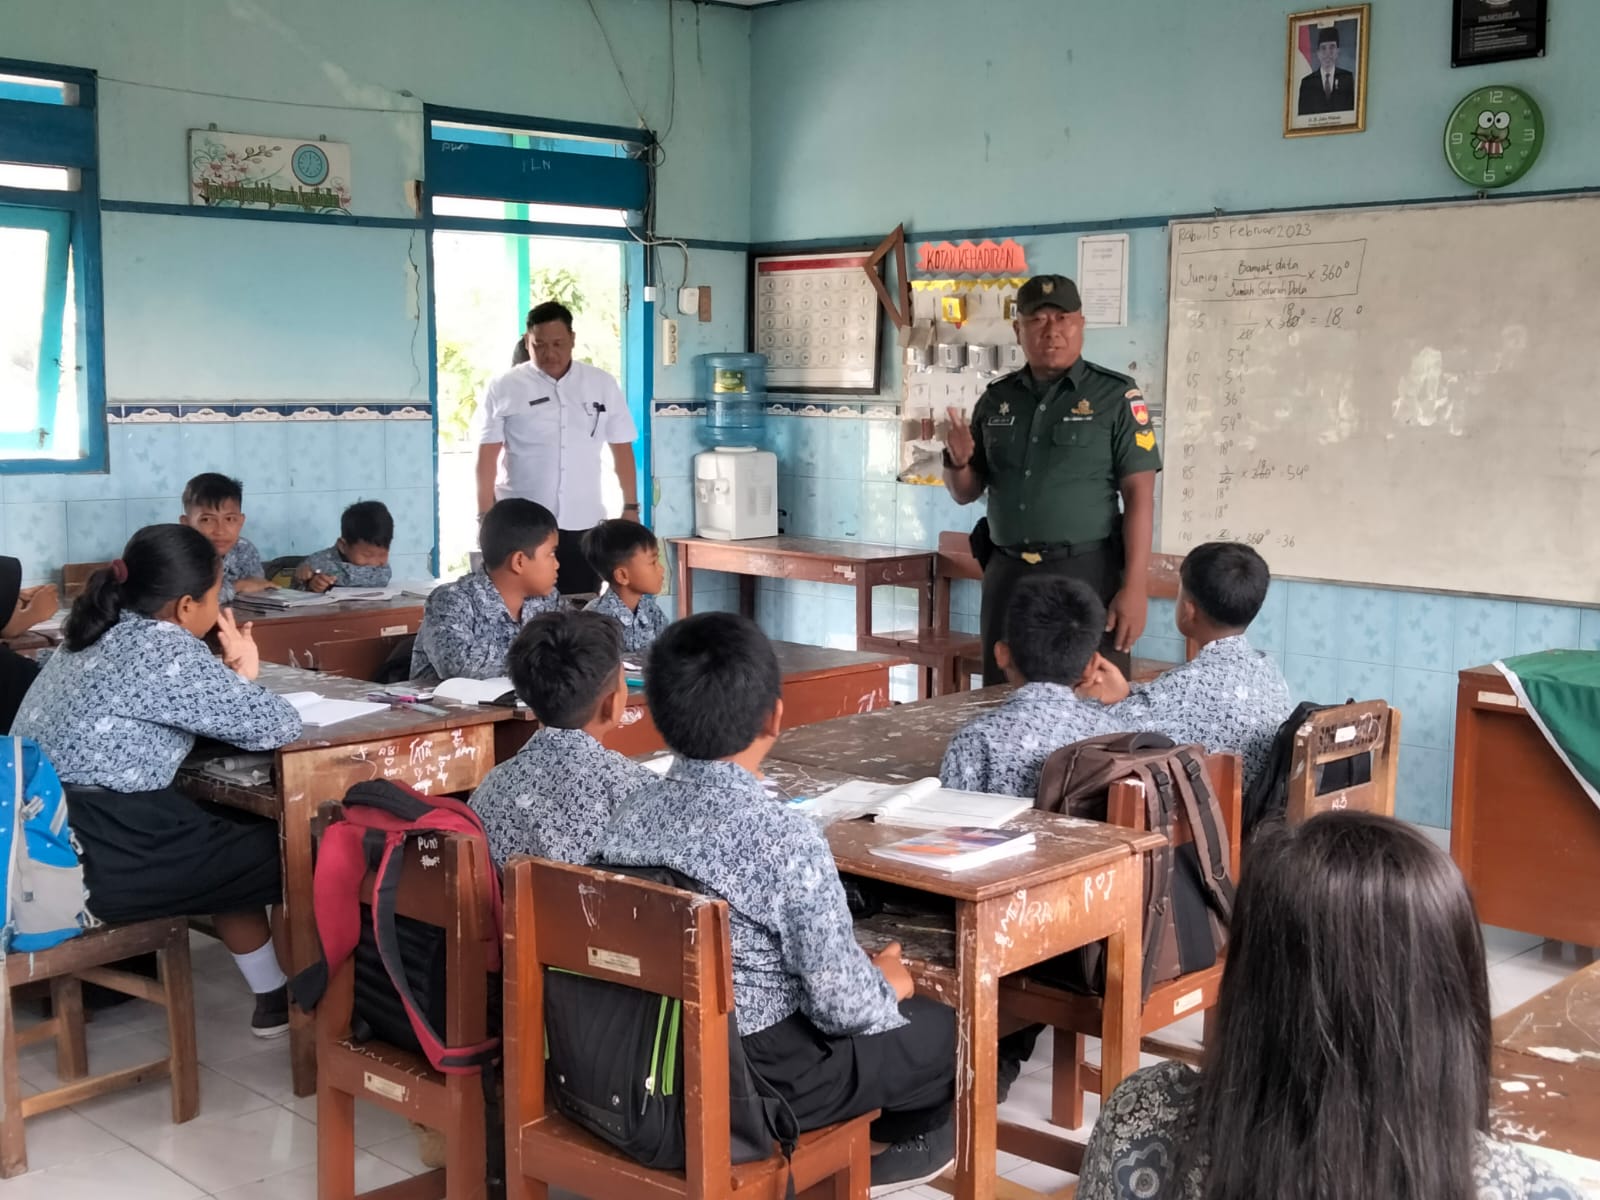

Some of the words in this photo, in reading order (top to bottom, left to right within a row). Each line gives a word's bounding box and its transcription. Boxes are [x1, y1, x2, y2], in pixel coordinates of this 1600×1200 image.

[1490, 91, 1503, 103] 12
[1452, 133, 1463, 144] 9
[1523, 128, 1535, 141] 3
[1484, 170, 1495, 182] 6
[1276, 223, 1312, 239] 2023
[926, 250, 957, 270] KOTAK
[958, 247, 1015, 270] KEHADIRAN
